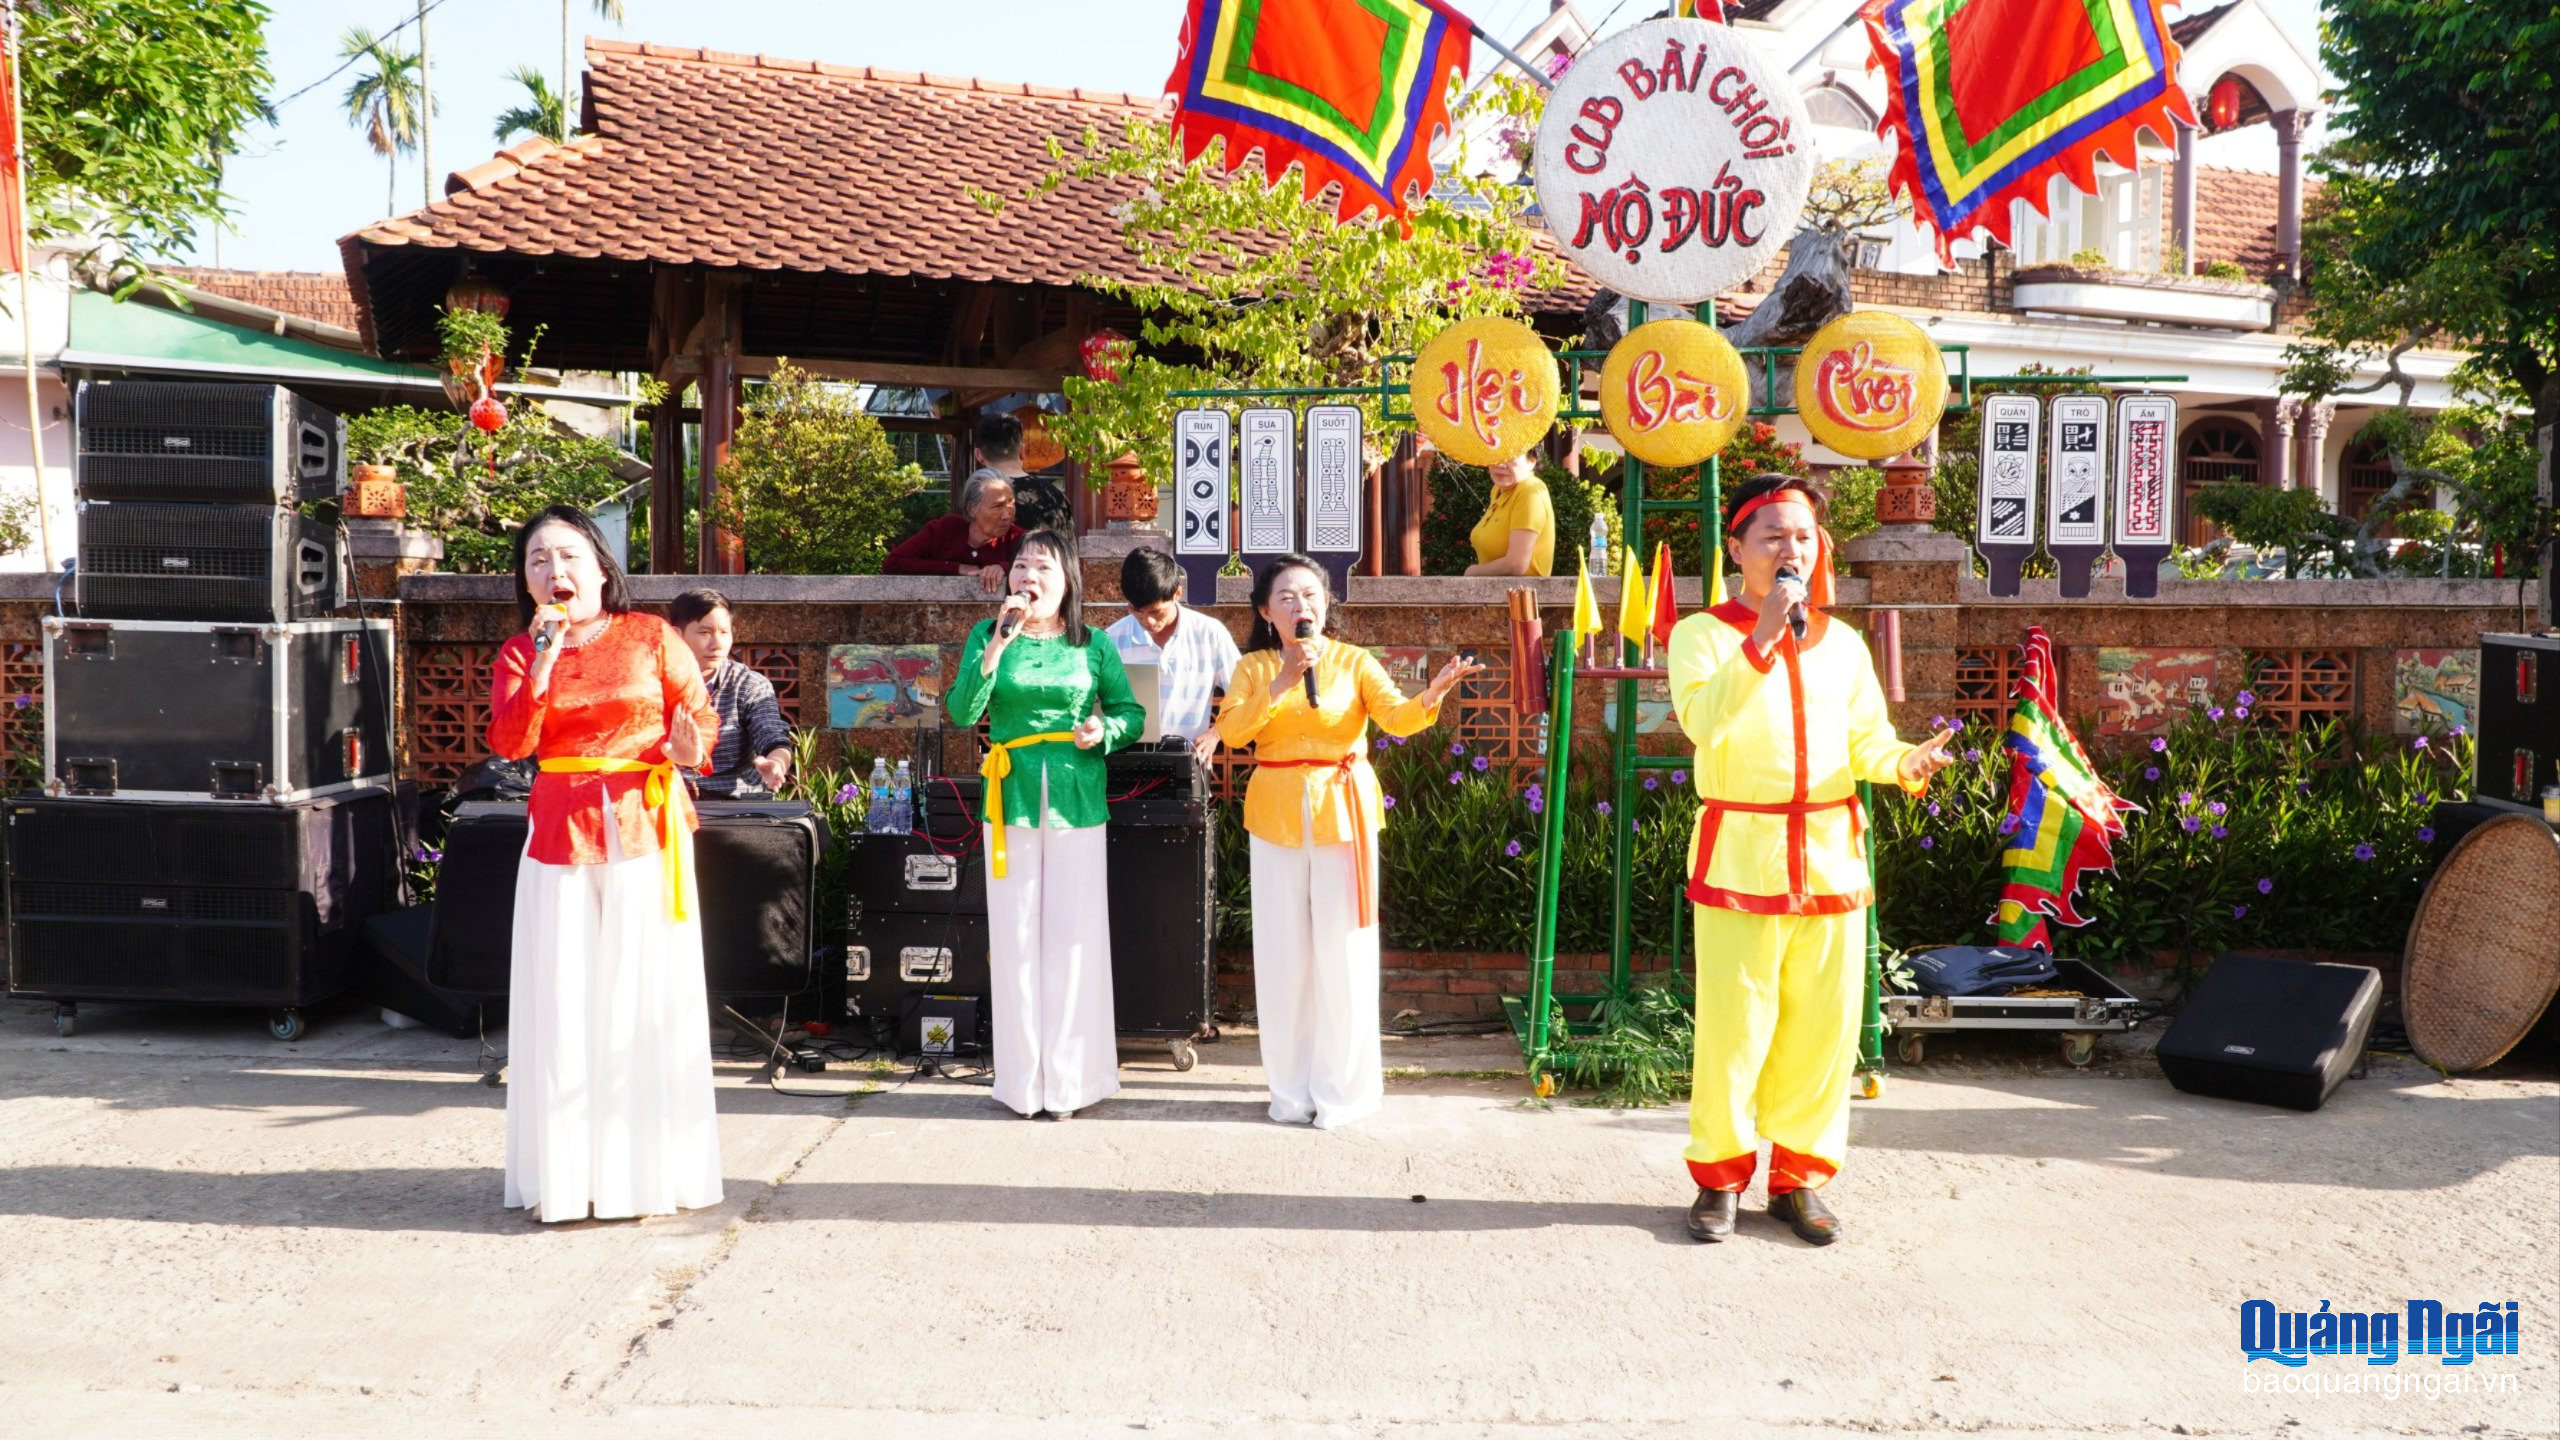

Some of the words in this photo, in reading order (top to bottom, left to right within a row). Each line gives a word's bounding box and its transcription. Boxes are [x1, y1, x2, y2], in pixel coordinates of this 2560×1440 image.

[1565, 96, 1623, 175] CLB
[1616, 38, 1708, 101] BÀI
[1708, 66, 1797, 160] CHÒI
[1571, 171, 1653, 265] MỘ
[1659, 159, 1766, 253] ĐỨC
[1436, 338, 1542, 448] Hội
[1626, 349, 1736, 434] Bài
[1815, 340, 1920, 433] Chòi
